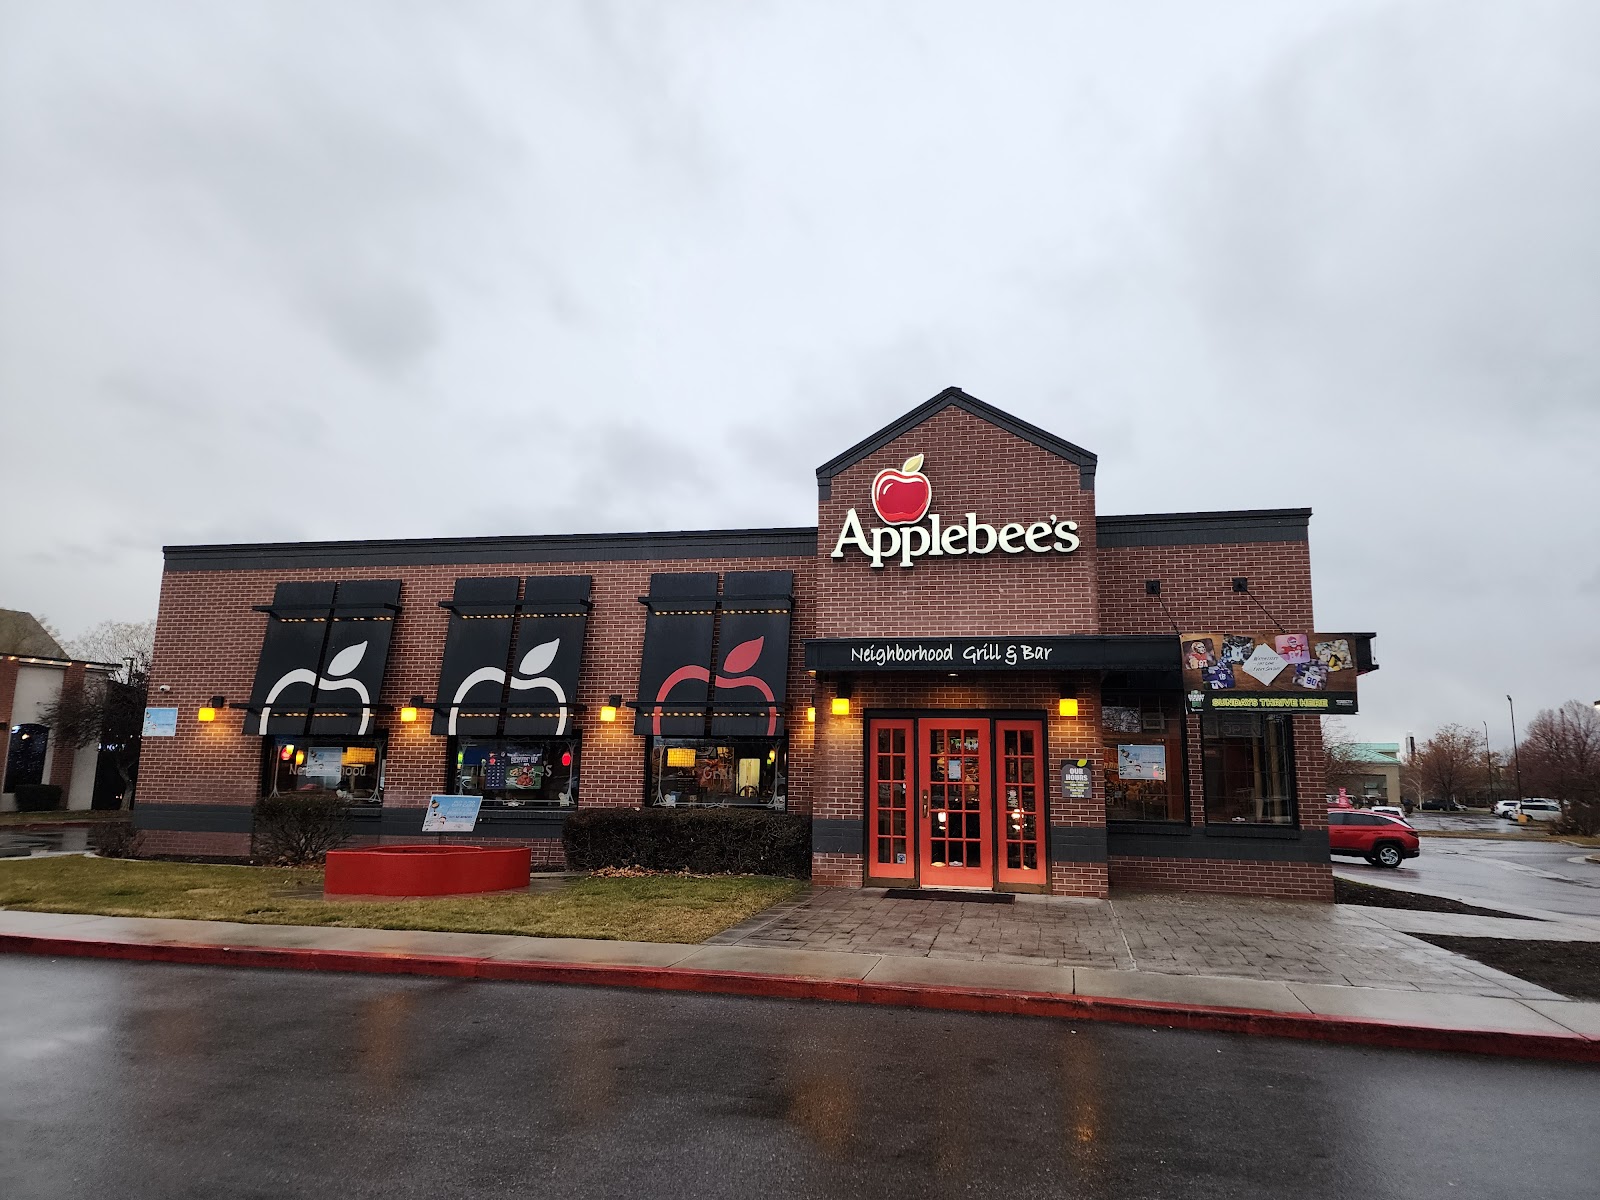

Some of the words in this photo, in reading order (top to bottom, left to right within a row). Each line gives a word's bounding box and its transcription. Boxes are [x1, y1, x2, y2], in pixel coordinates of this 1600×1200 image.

[831, 508, 1080, 568] Applebee's
[851, 643, 953, 665] Neighborhood
[963, 643, 1001, 664] Grill
[1005, 645, 1017, 664] &
[1022, 645, 1053, 661] Bar
[1306, 677, 1317, 686] 90
[1212, 698, 1258, 707] SUNDAYS
[1259, 698, 1298, 707] THRIVE
[1300, 698, 1329, 708] HERE
